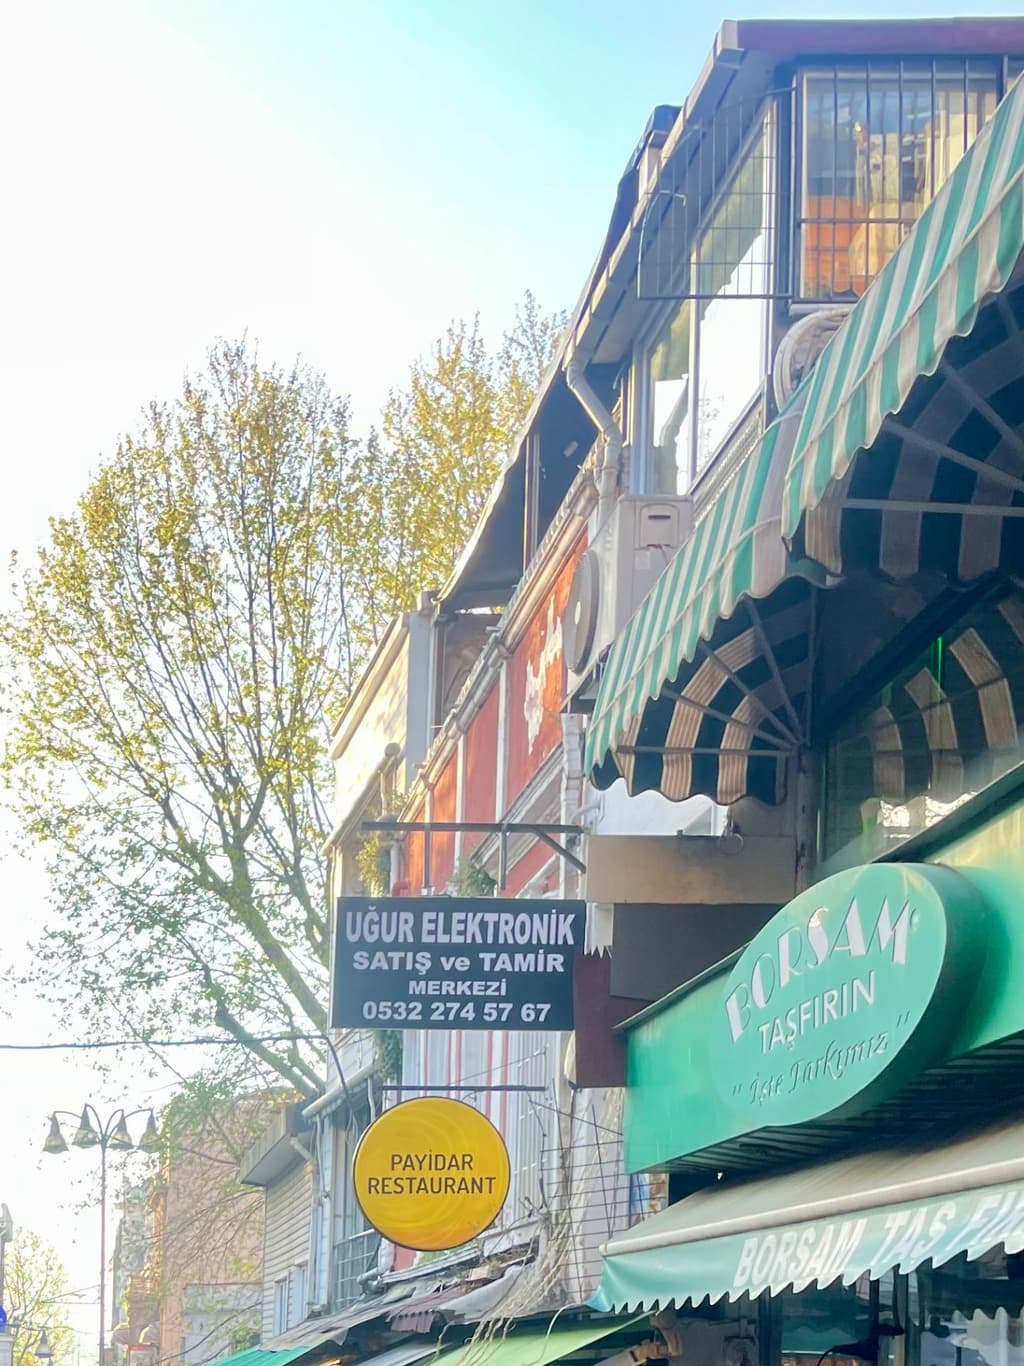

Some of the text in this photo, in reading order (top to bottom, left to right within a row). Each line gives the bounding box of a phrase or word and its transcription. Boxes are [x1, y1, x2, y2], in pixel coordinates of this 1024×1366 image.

[346, 906, 576, 945] UĞUR ELEKTRONİK
[352, 950, 565, 975] SATIŞ ve TAMİR
[725, 895, 910, 1043] BORSAM
[408, 978, 507, 996] MERKEZİ
[362, 1001, 552, 1022] 0532 274 57 67
[758, 970, 875, 1054] TAŞFIRIN
[390, 1149, 474, 1171] PAYİDAR
[367, 1176, 497, 1195] RESTAURANT
[732, 1218, 868, 1289] BORSAM
